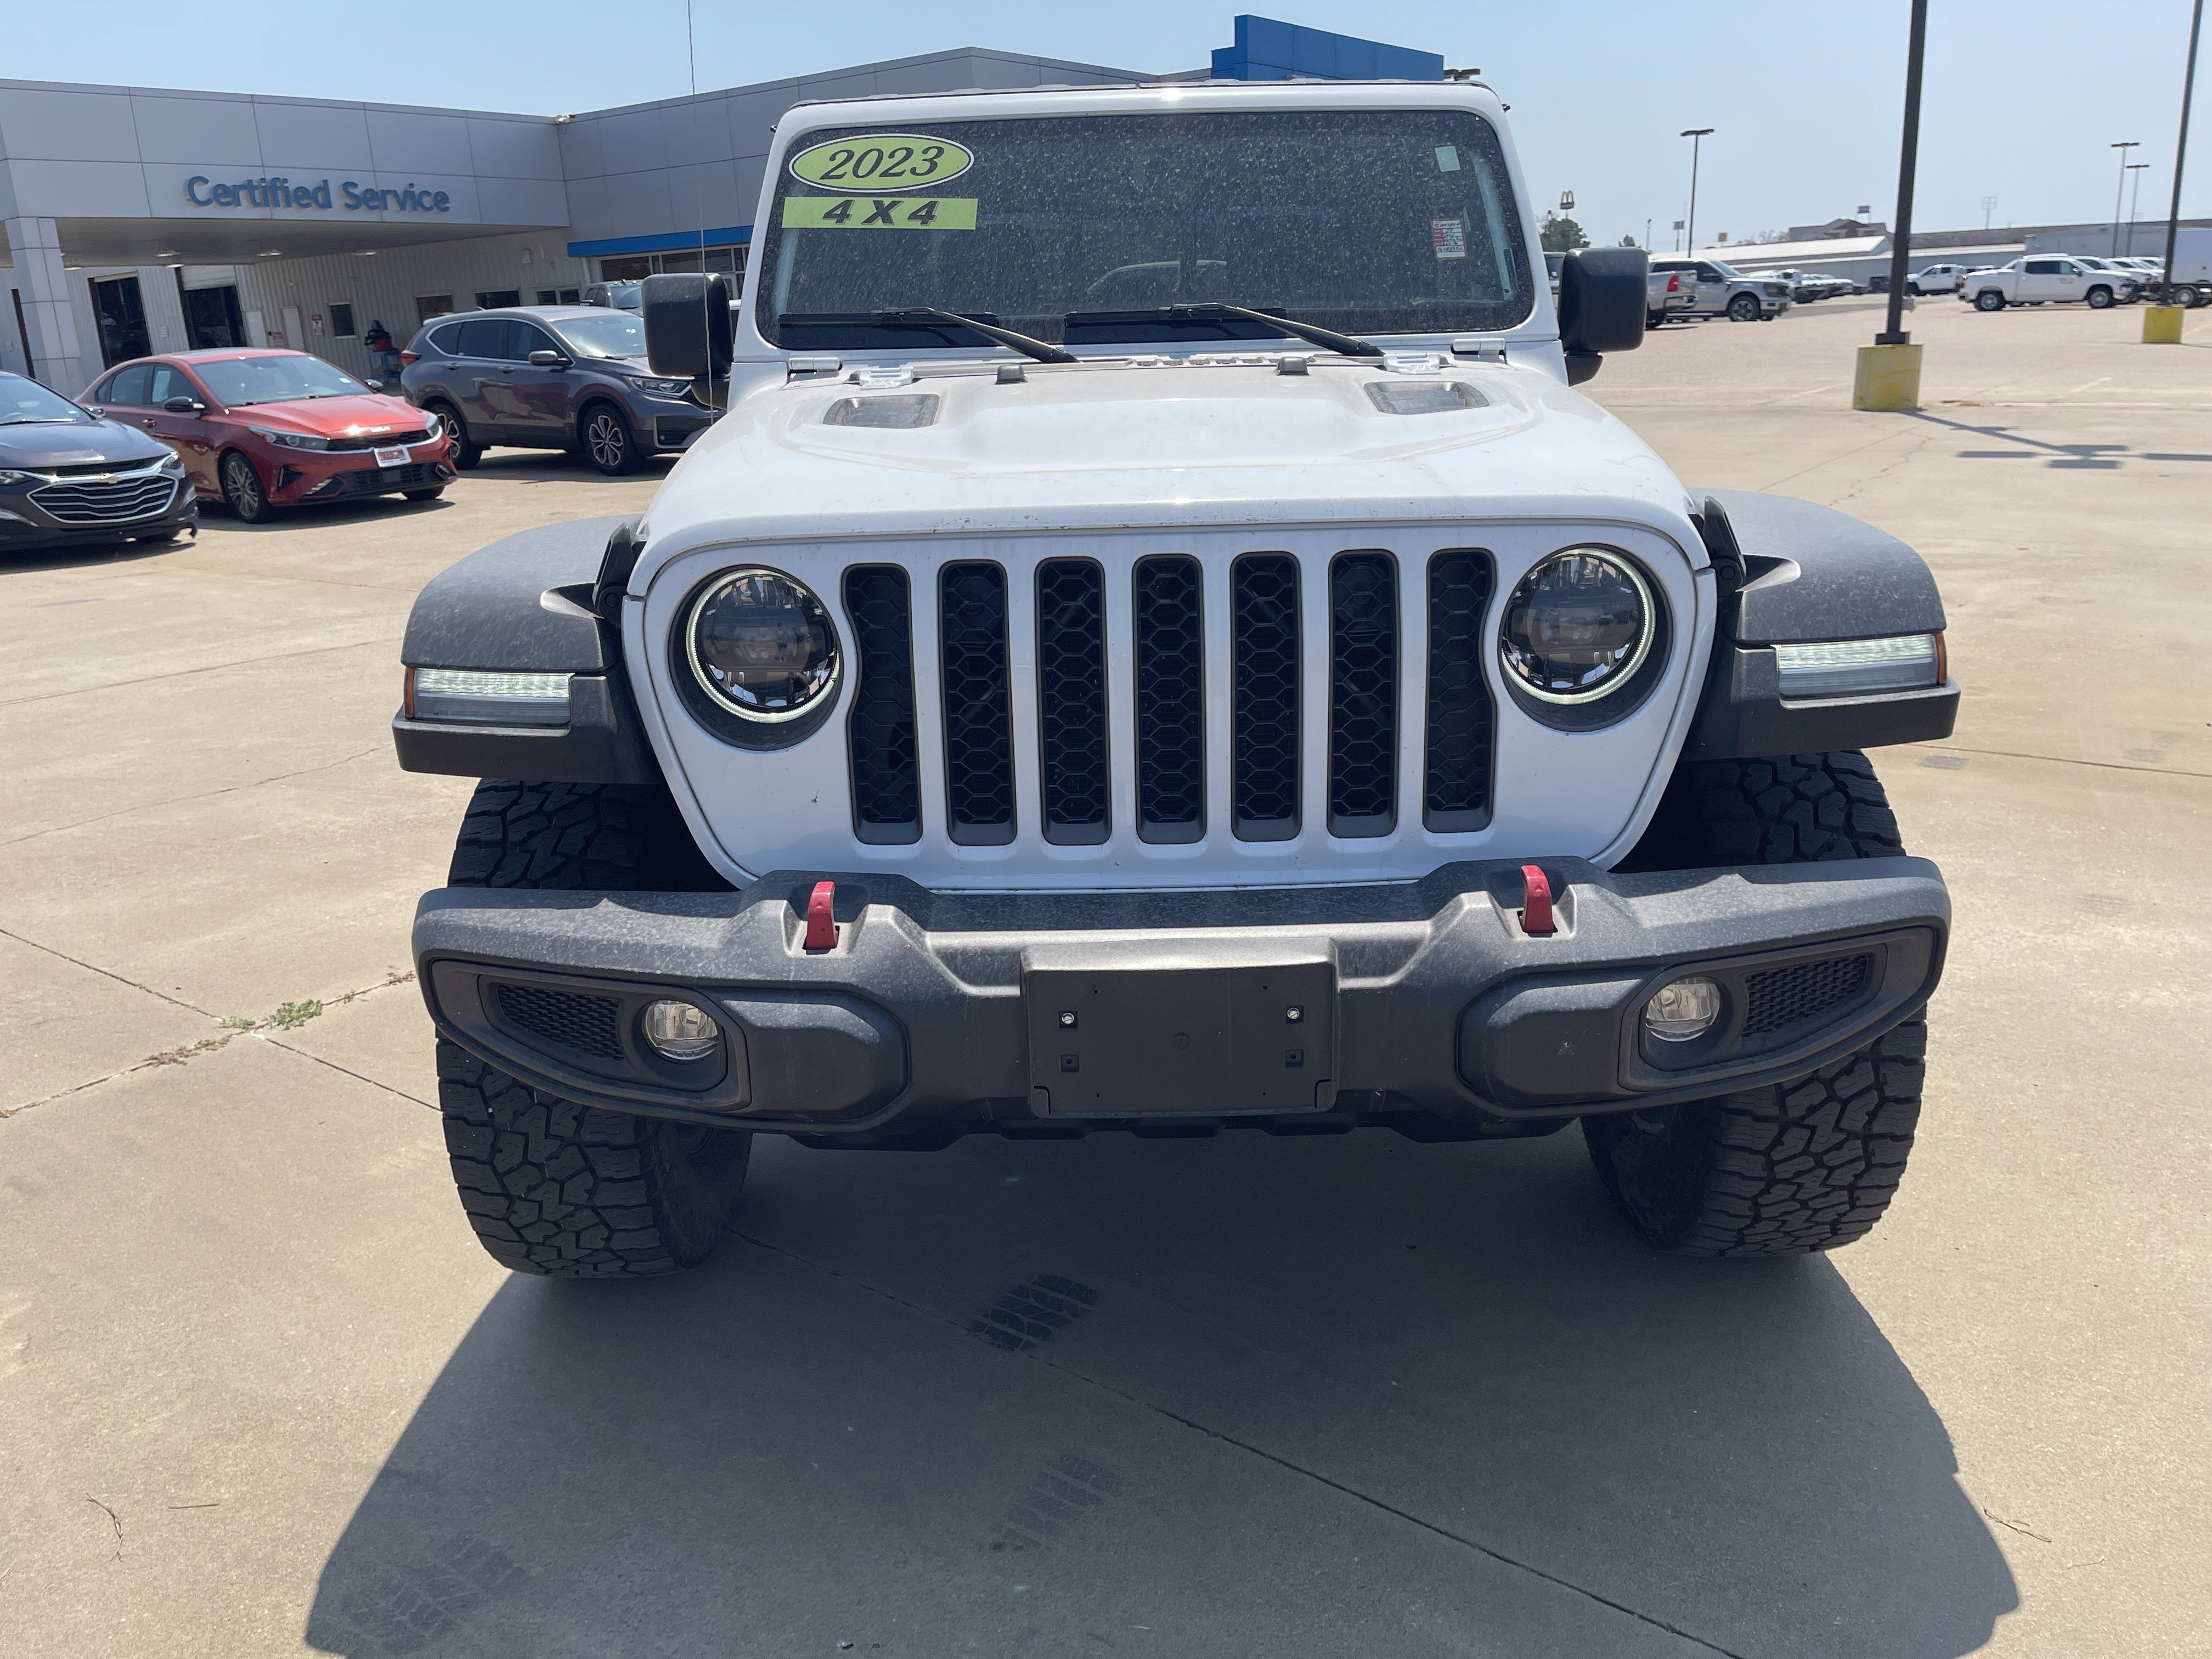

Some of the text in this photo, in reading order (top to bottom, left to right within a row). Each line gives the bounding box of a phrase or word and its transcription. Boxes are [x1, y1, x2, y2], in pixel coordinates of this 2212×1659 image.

[819, 146, 945, 180] 2023
[187, 175, 450, 212] Certified Service
